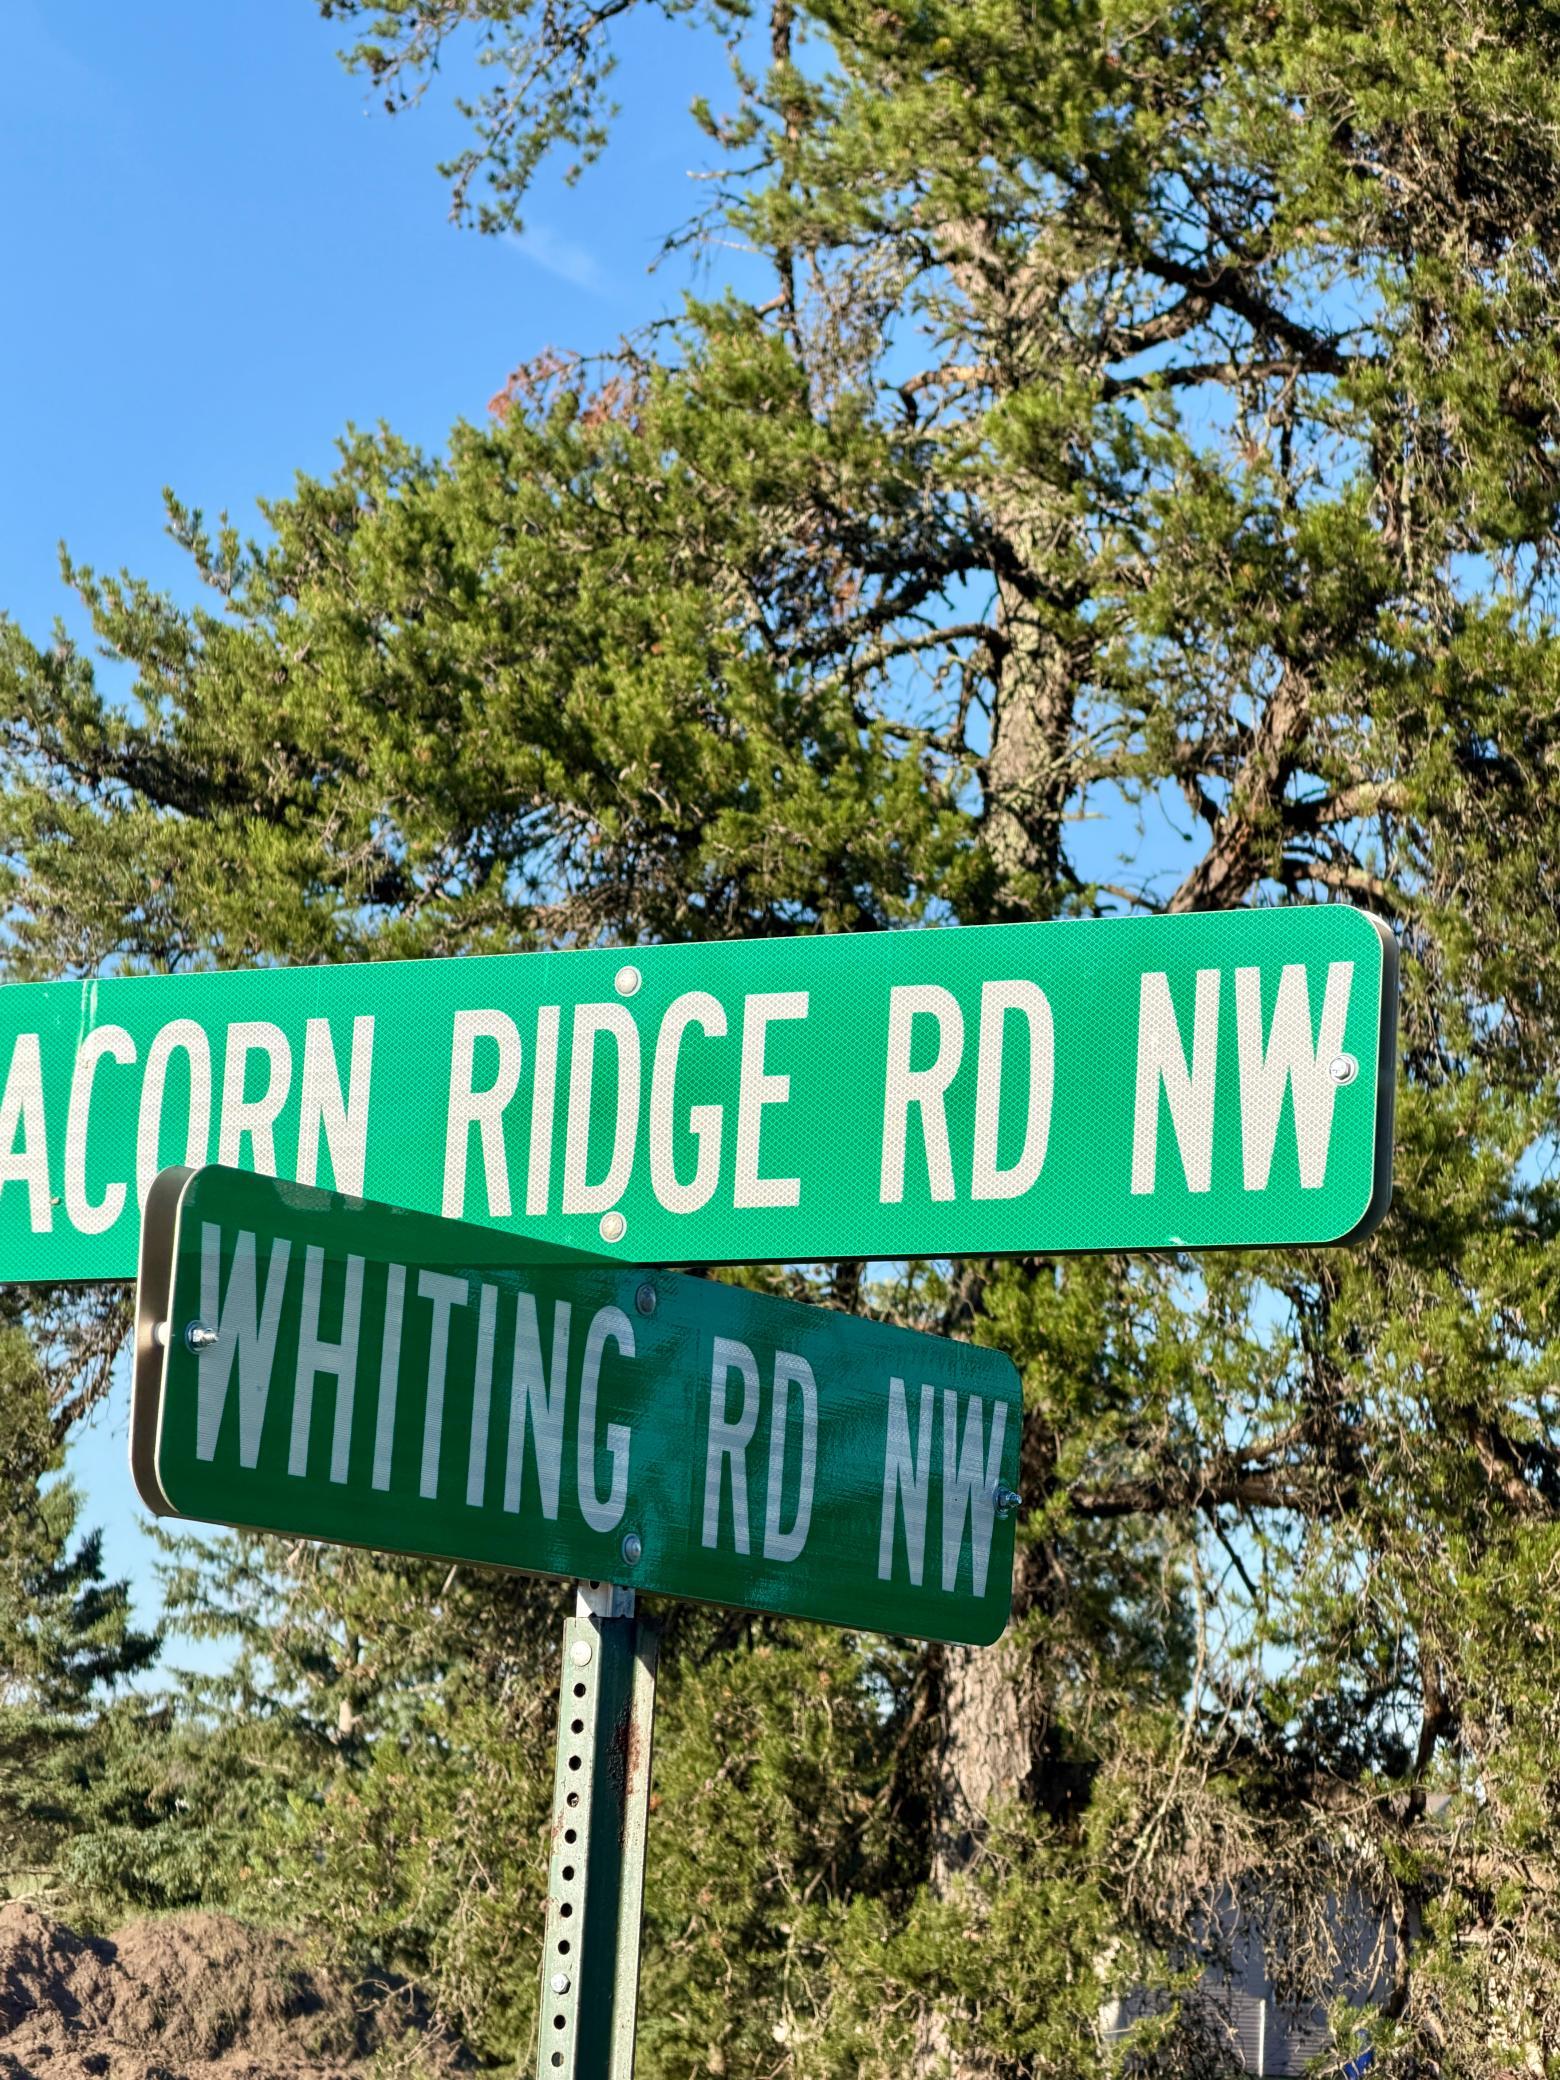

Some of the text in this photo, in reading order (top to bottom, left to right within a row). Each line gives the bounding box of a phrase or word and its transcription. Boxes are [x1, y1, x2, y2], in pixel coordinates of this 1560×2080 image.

[0, 961, 1354, 1235] ACORN RIDGE RD NW
[196, 1221, 1008, 1598] WHITING RD NW
